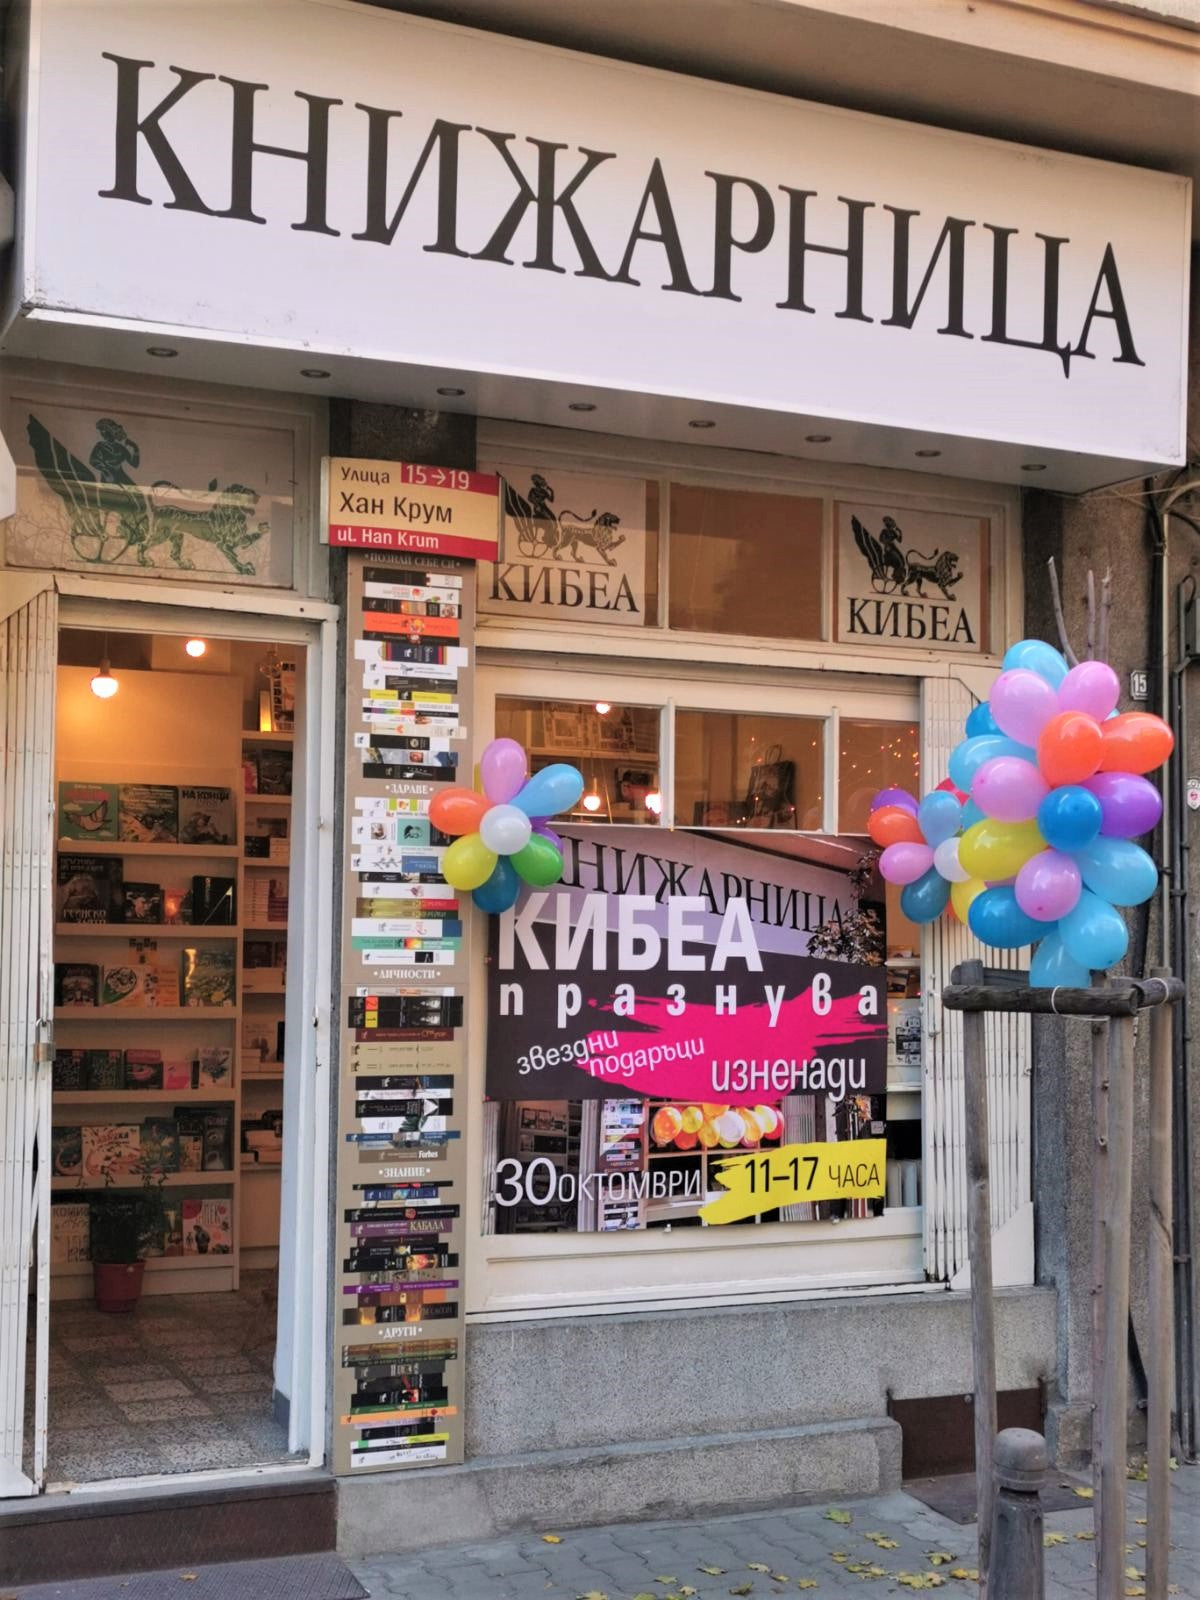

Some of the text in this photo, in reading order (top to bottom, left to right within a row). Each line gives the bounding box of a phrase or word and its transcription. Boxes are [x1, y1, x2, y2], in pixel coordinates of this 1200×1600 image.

[98, 52, 1146, 379] КНИЖАРНИЦА
[340, 465, 391, 485] Улица
[406, 463, 470, 490] 15 19
[339, 491, 453, 524] Хан Крум
[337, 527, 439, 549] ul. Han Krum
[489, 561, 640, 613] КИБЕА
[846, 596, 977, 644] КИБЕА
[1133, 673, 1147, 693] 15
[390, 783, 428, 795] ЗДРАВЕ
[557, 834, 847, 935] НИЖАРНИЦА
[499, 892, 763, 972] КИБЕА
[379, 969, 436, 980] ЛИЧНОСТИ
[500, 972, 879, 1028] празнува
[516, 1030, 619, 1076] звездни
[588, 1034, 706, 1078] подаръци
[711, 1057, 867, 1101] изненади
[418, 1150, 439, 1159] Forbes
[383, 1166, 426, 1178] ЗНАНИЕ
[495, 1157, 701, 1207] 30 ОКТОМВРИ
[828, 1162, 881, 1189] ЧАСА
[383, 1326, 417, 1339] ДРУГИ
